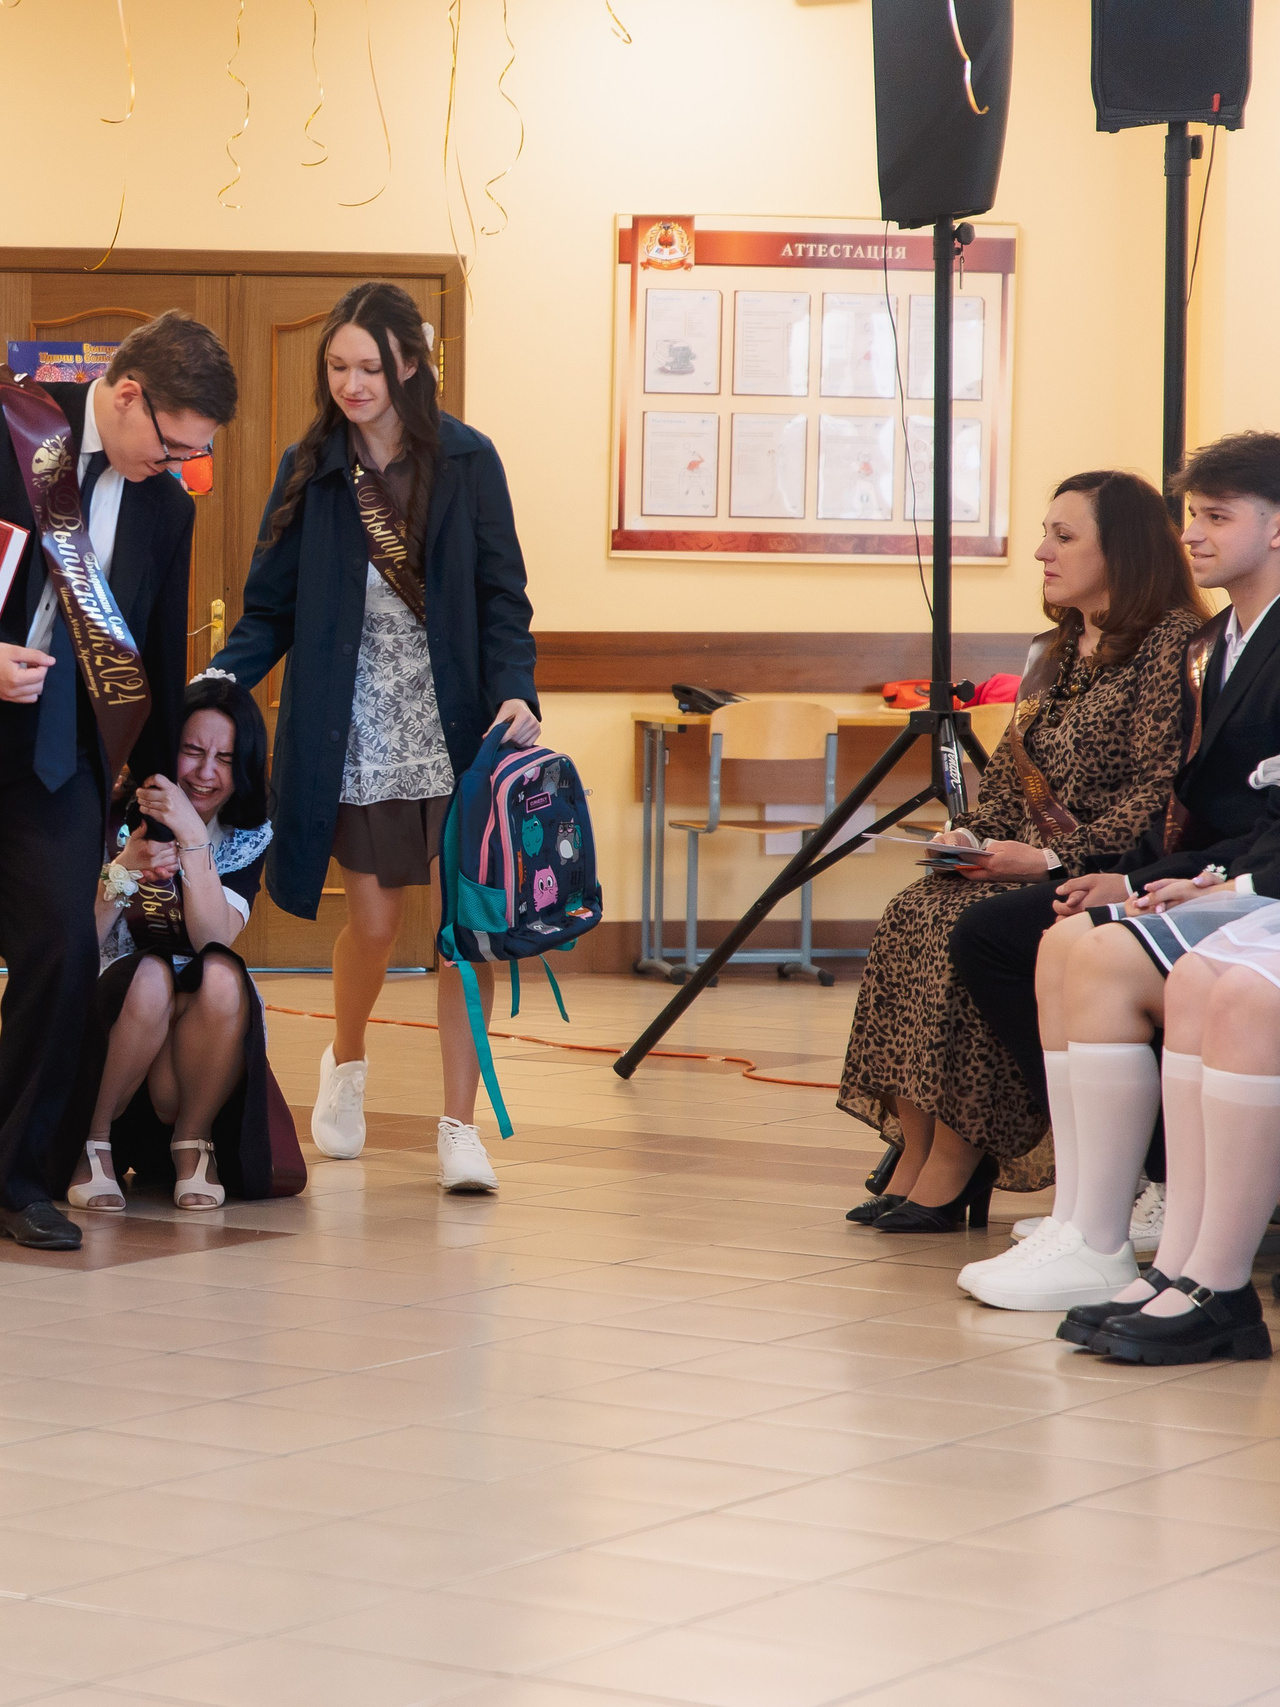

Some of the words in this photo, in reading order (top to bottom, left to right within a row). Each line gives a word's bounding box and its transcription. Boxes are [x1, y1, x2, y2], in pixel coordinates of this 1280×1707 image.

[781, 242, 907, 261] АТТЕСТАЦИЯ
[39, 352, 74, 364] Удачи
[75, 354, 83, 364] в
[47, 488, 116, 654] Выпускник
[94, 650, 147, 706] 2024
[107, 613, 126, 641] Олег
